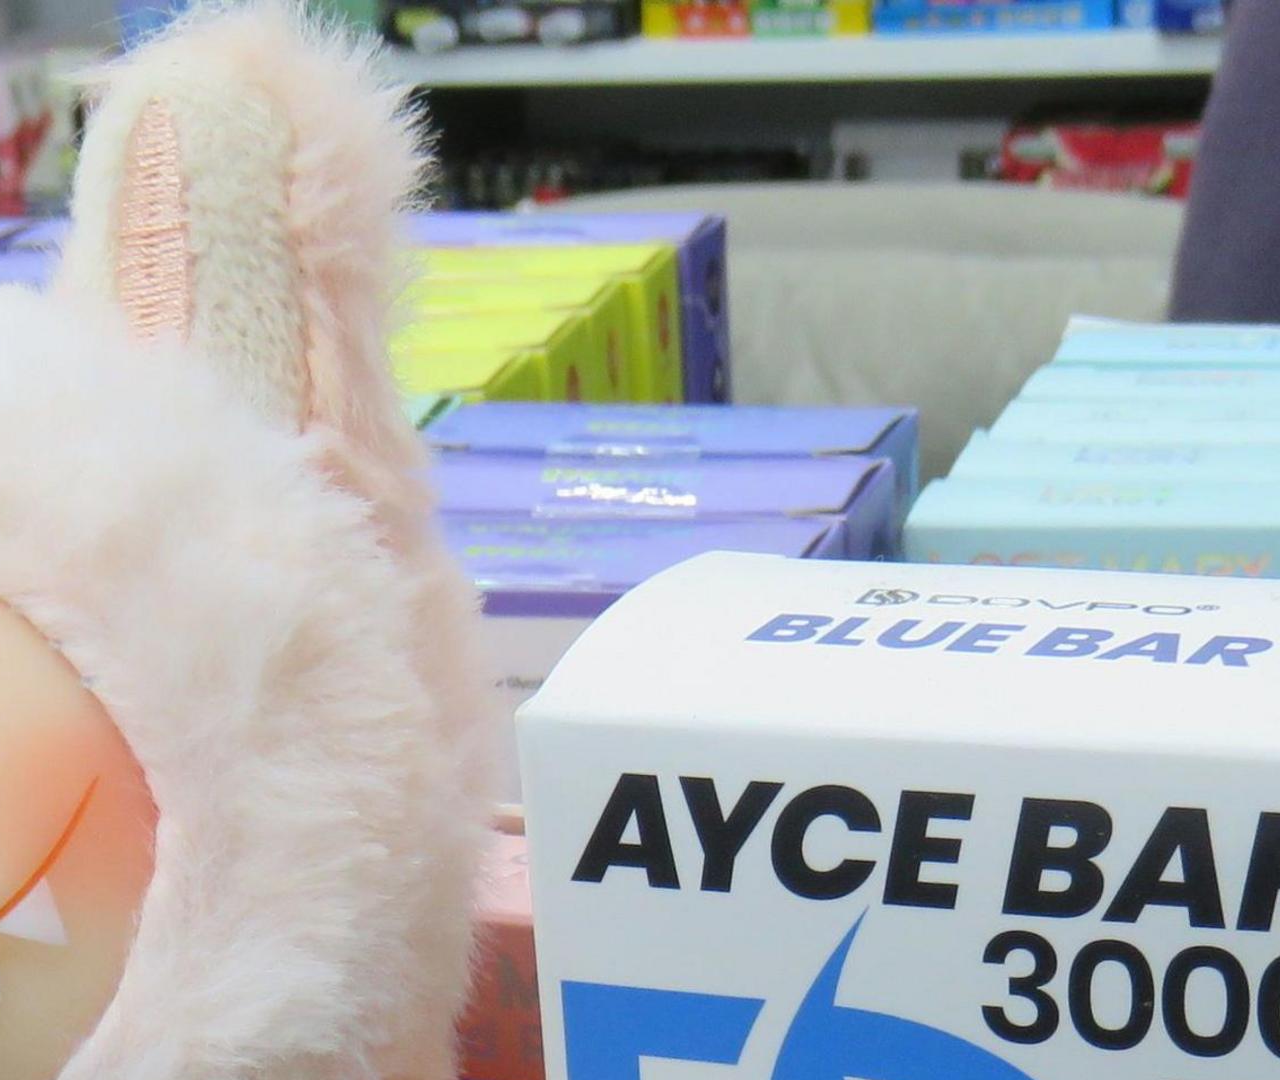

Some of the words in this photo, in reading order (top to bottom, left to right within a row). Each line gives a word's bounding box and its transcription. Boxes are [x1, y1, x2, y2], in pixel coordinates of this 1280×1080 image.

[743, 612, 1027, 654] BLUE
[1023, 626, 1275, 668] BAR
[570, 772, 977, 912] AYCE
